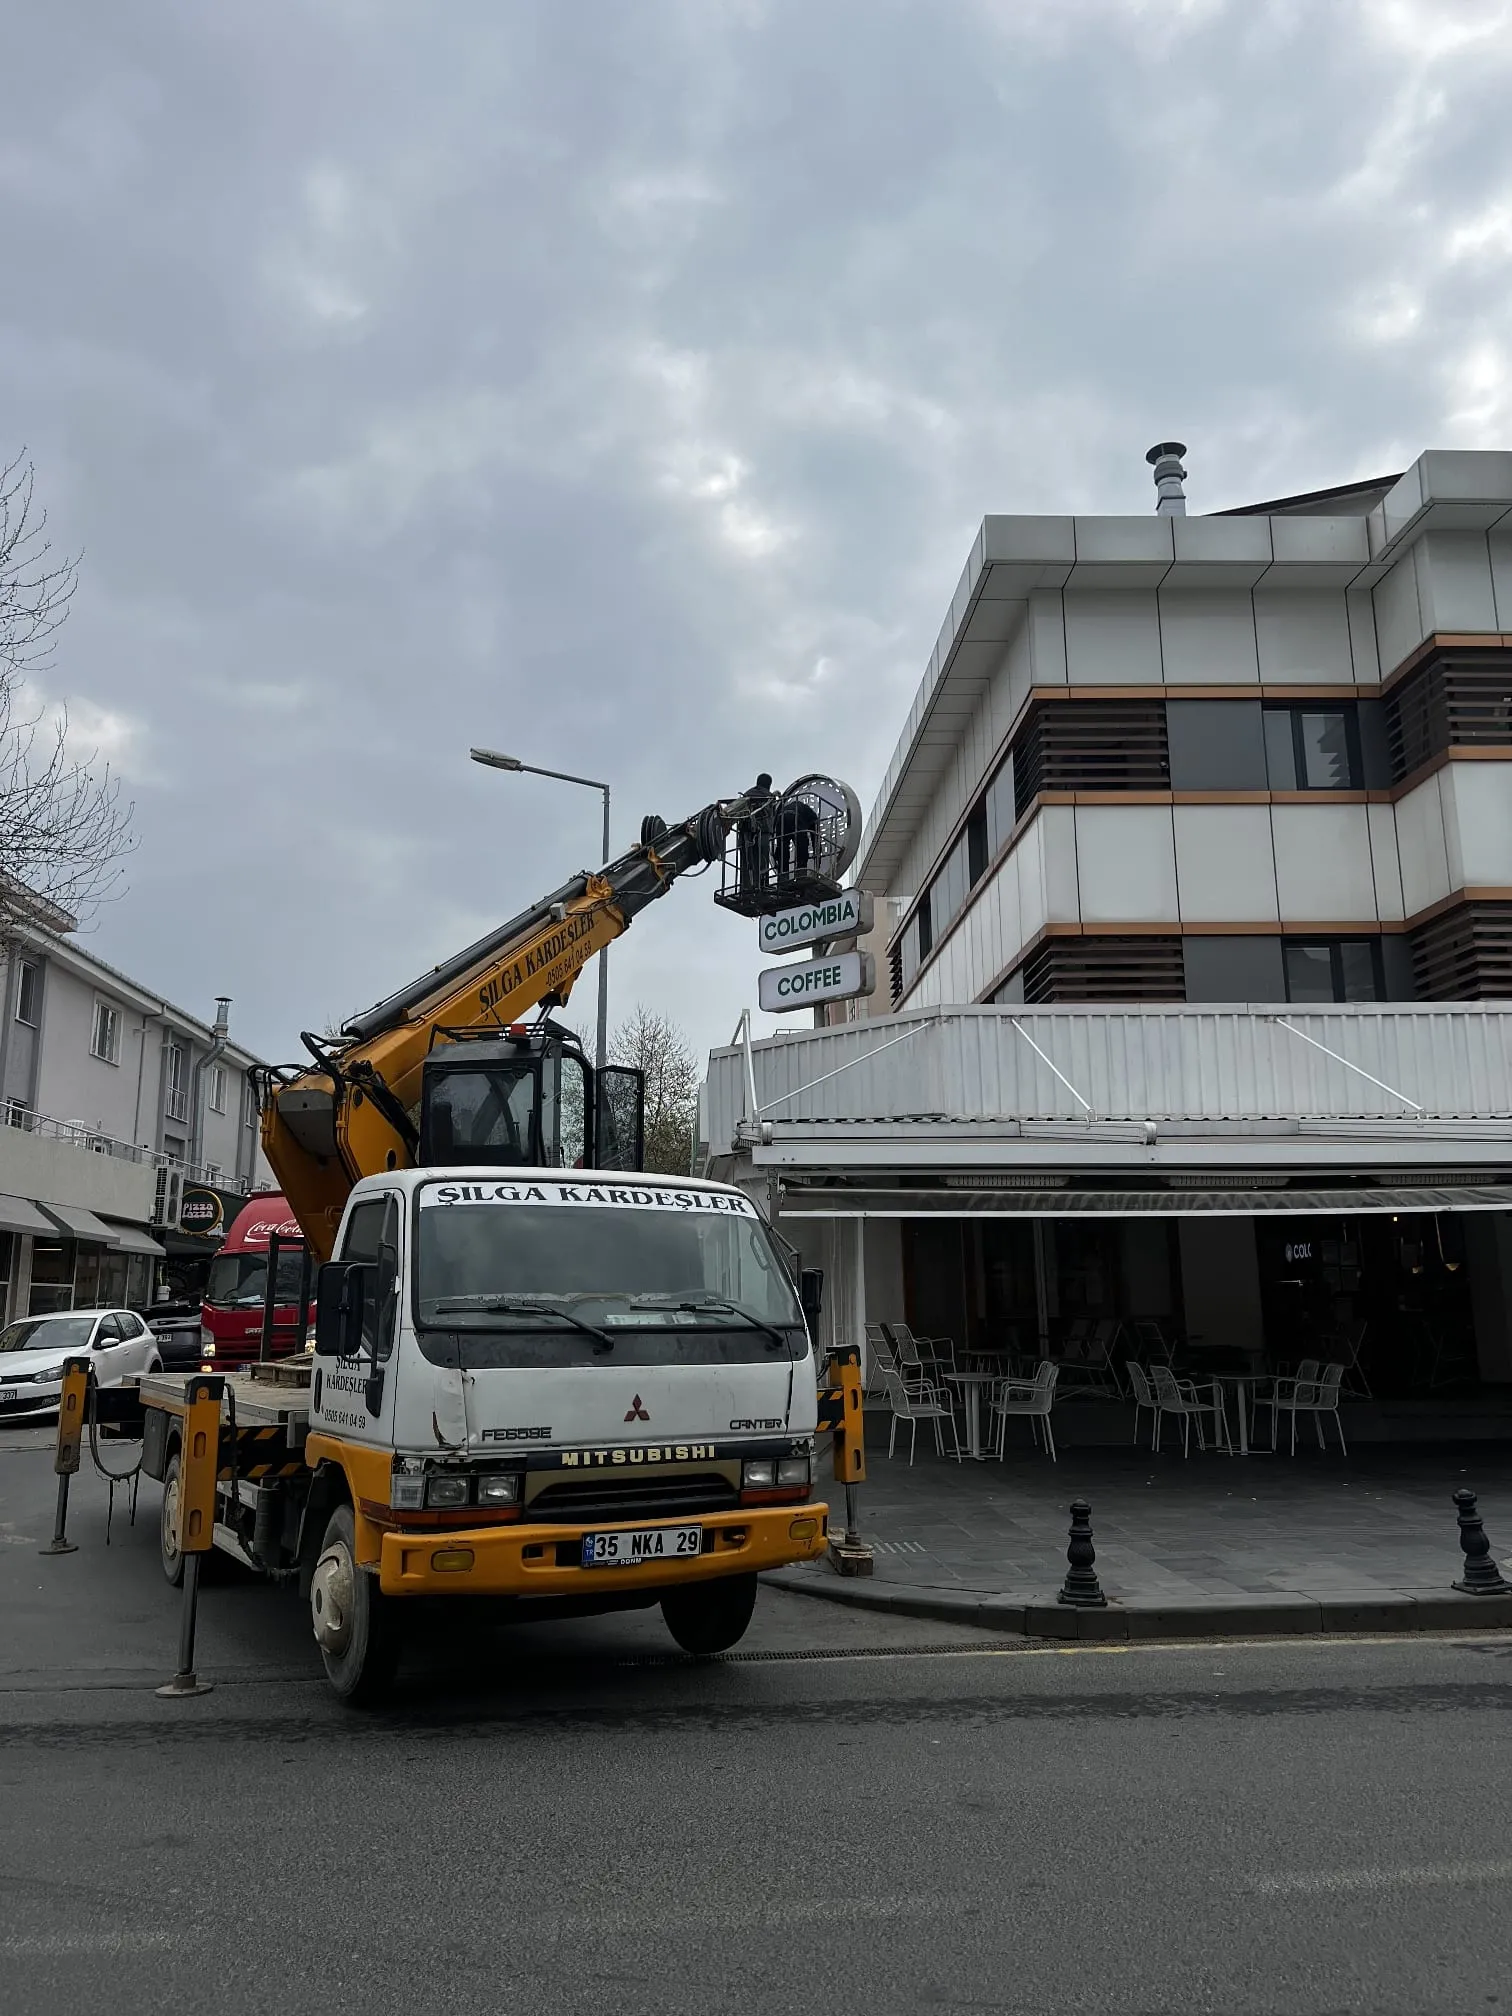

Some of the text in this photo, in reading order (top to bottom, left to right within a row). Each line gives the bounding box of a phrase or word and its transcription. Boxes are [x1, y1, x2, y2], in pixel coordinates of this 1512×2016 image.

[764, 900, 855, 941] COLOMBIA
[777, 965, 841, 996] COFFEE
[729, 1418, 783, 1430] CANTER
[562, 1446, 716, 1467] MITSUBISHI
[595, 1531, 698, 1557] 35 NKA 29
